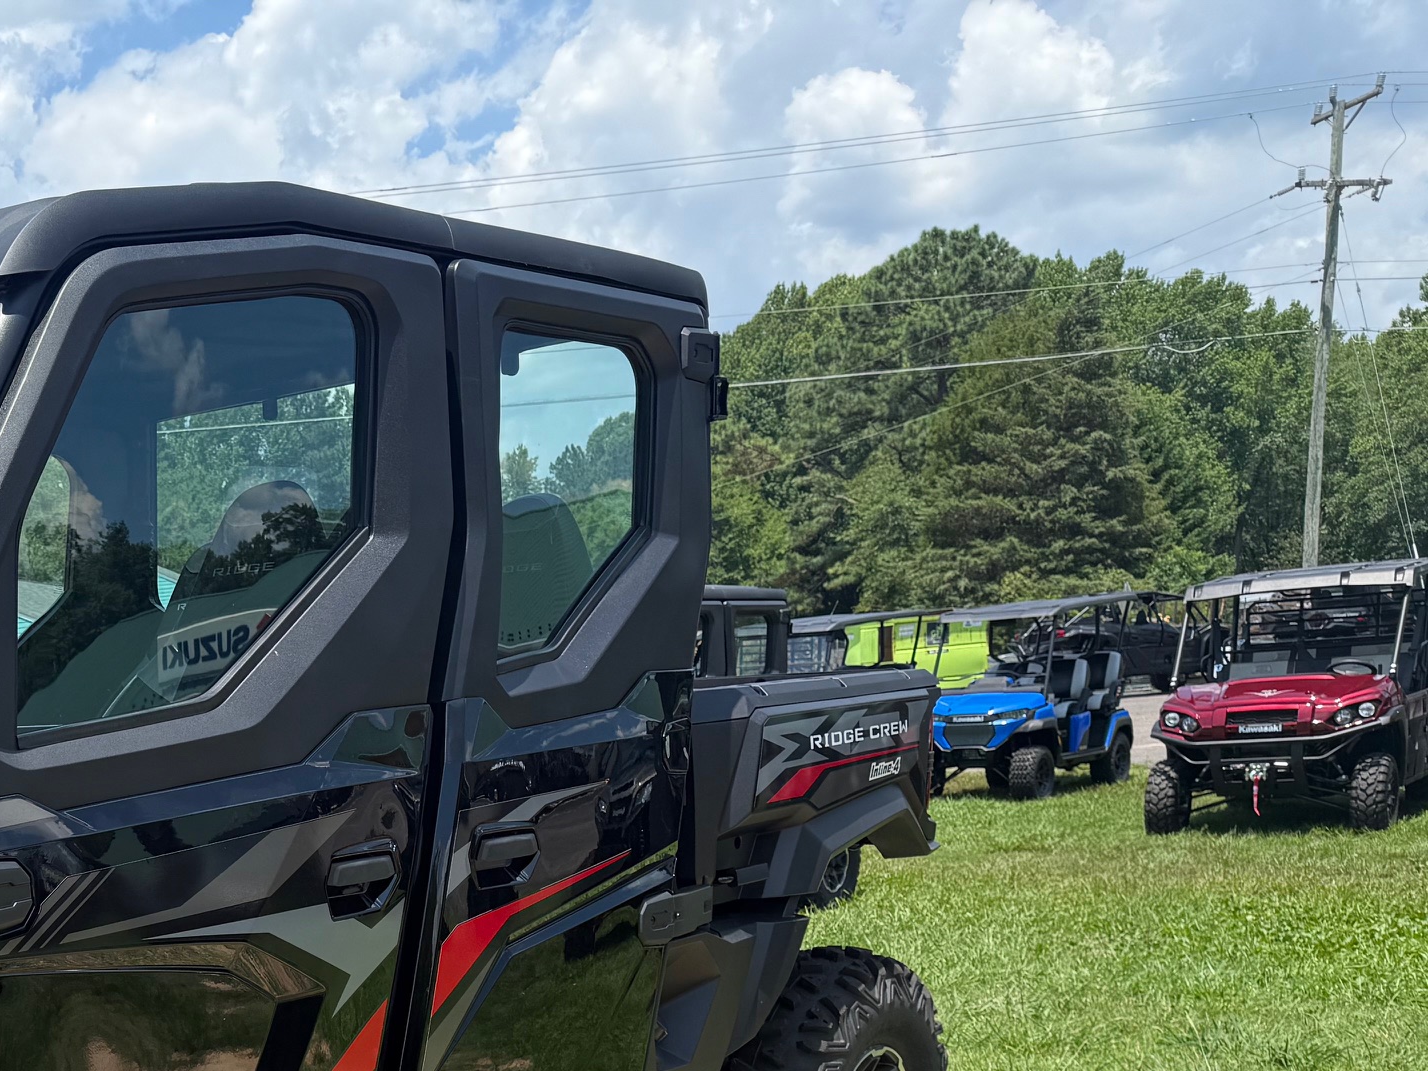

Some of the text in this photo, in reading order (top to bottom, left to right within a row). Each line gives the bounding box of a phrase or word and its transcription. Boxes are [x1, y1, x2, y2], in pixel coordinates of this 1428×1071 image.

[810, 719, 908, 750] RIDGE CREW
[1238, 723, 1283, 733] Kawasaki
